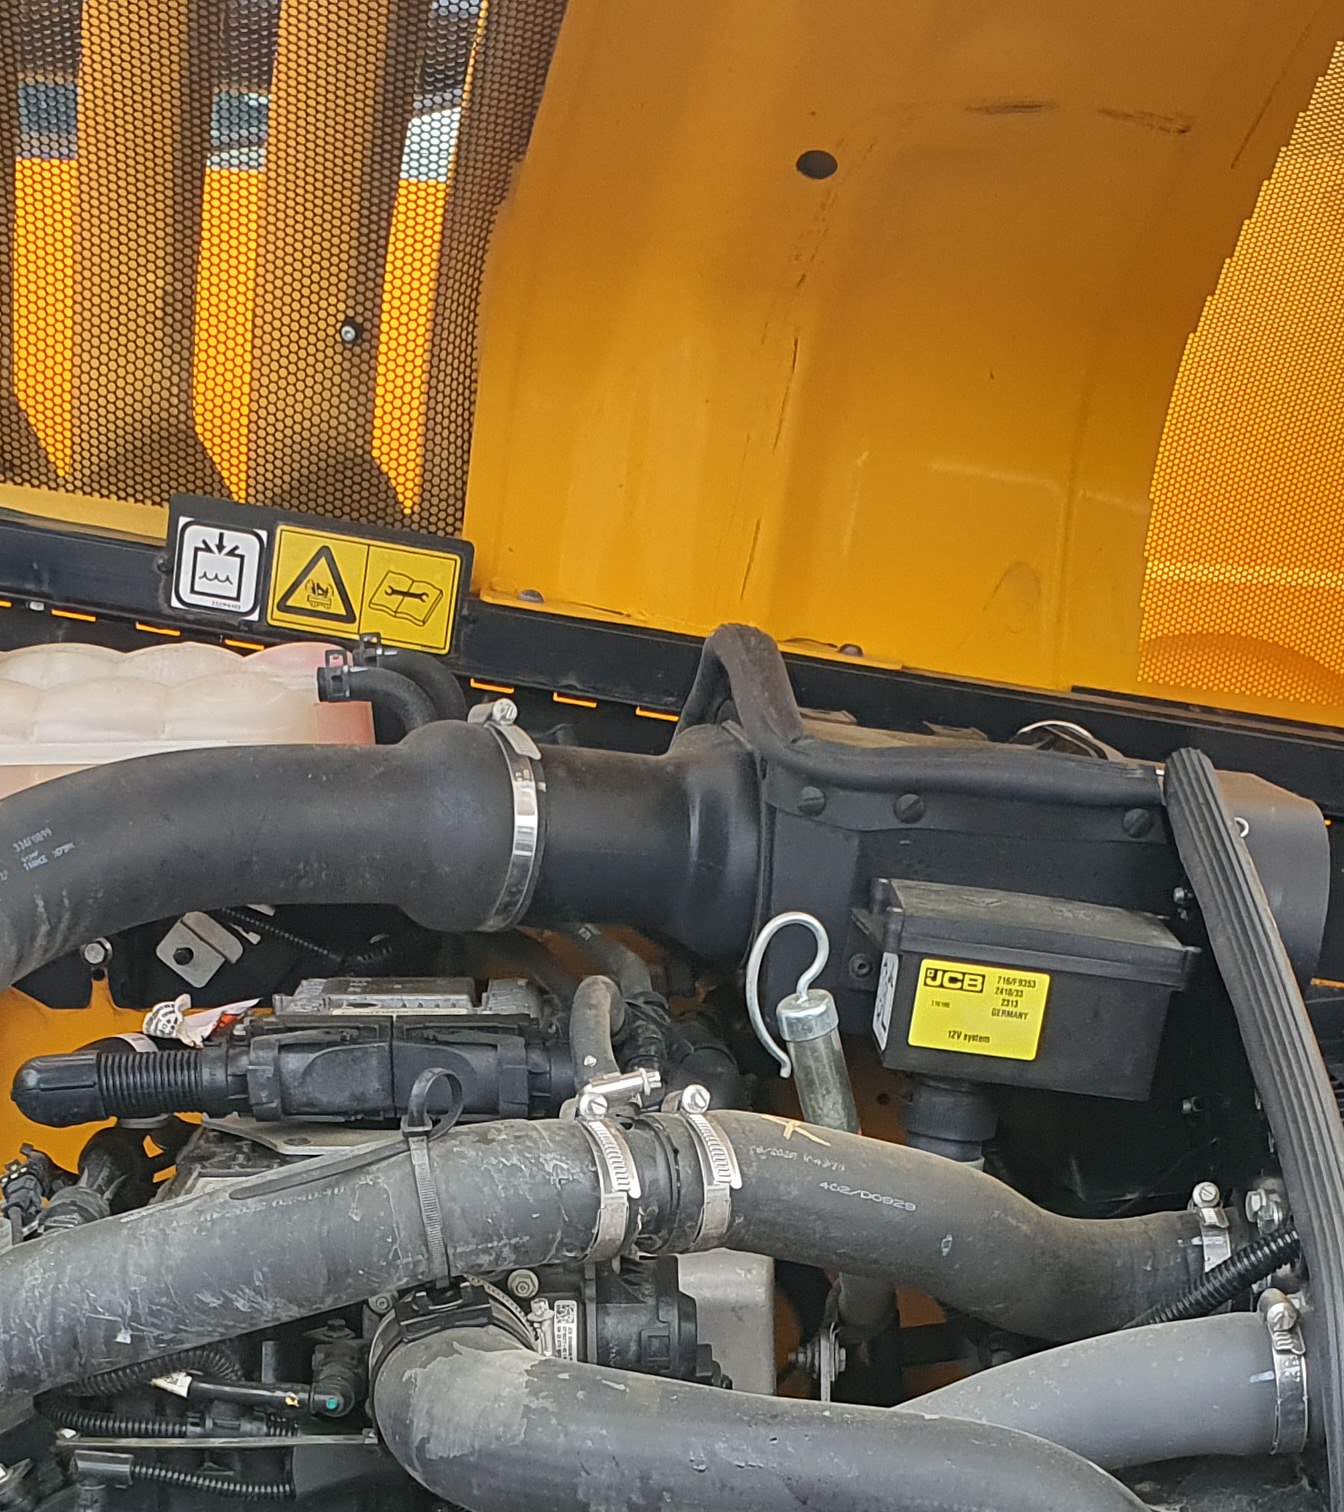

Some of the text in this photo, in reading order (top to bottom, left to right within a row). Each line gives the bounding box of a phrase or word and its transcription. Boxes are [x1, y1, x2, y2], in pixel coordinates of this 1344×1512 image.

[925, 968, 985, 993] JCB
[991, 1007, 1030, 1020] GERMANY
[947, 1030, 991, 1044] 12V system
